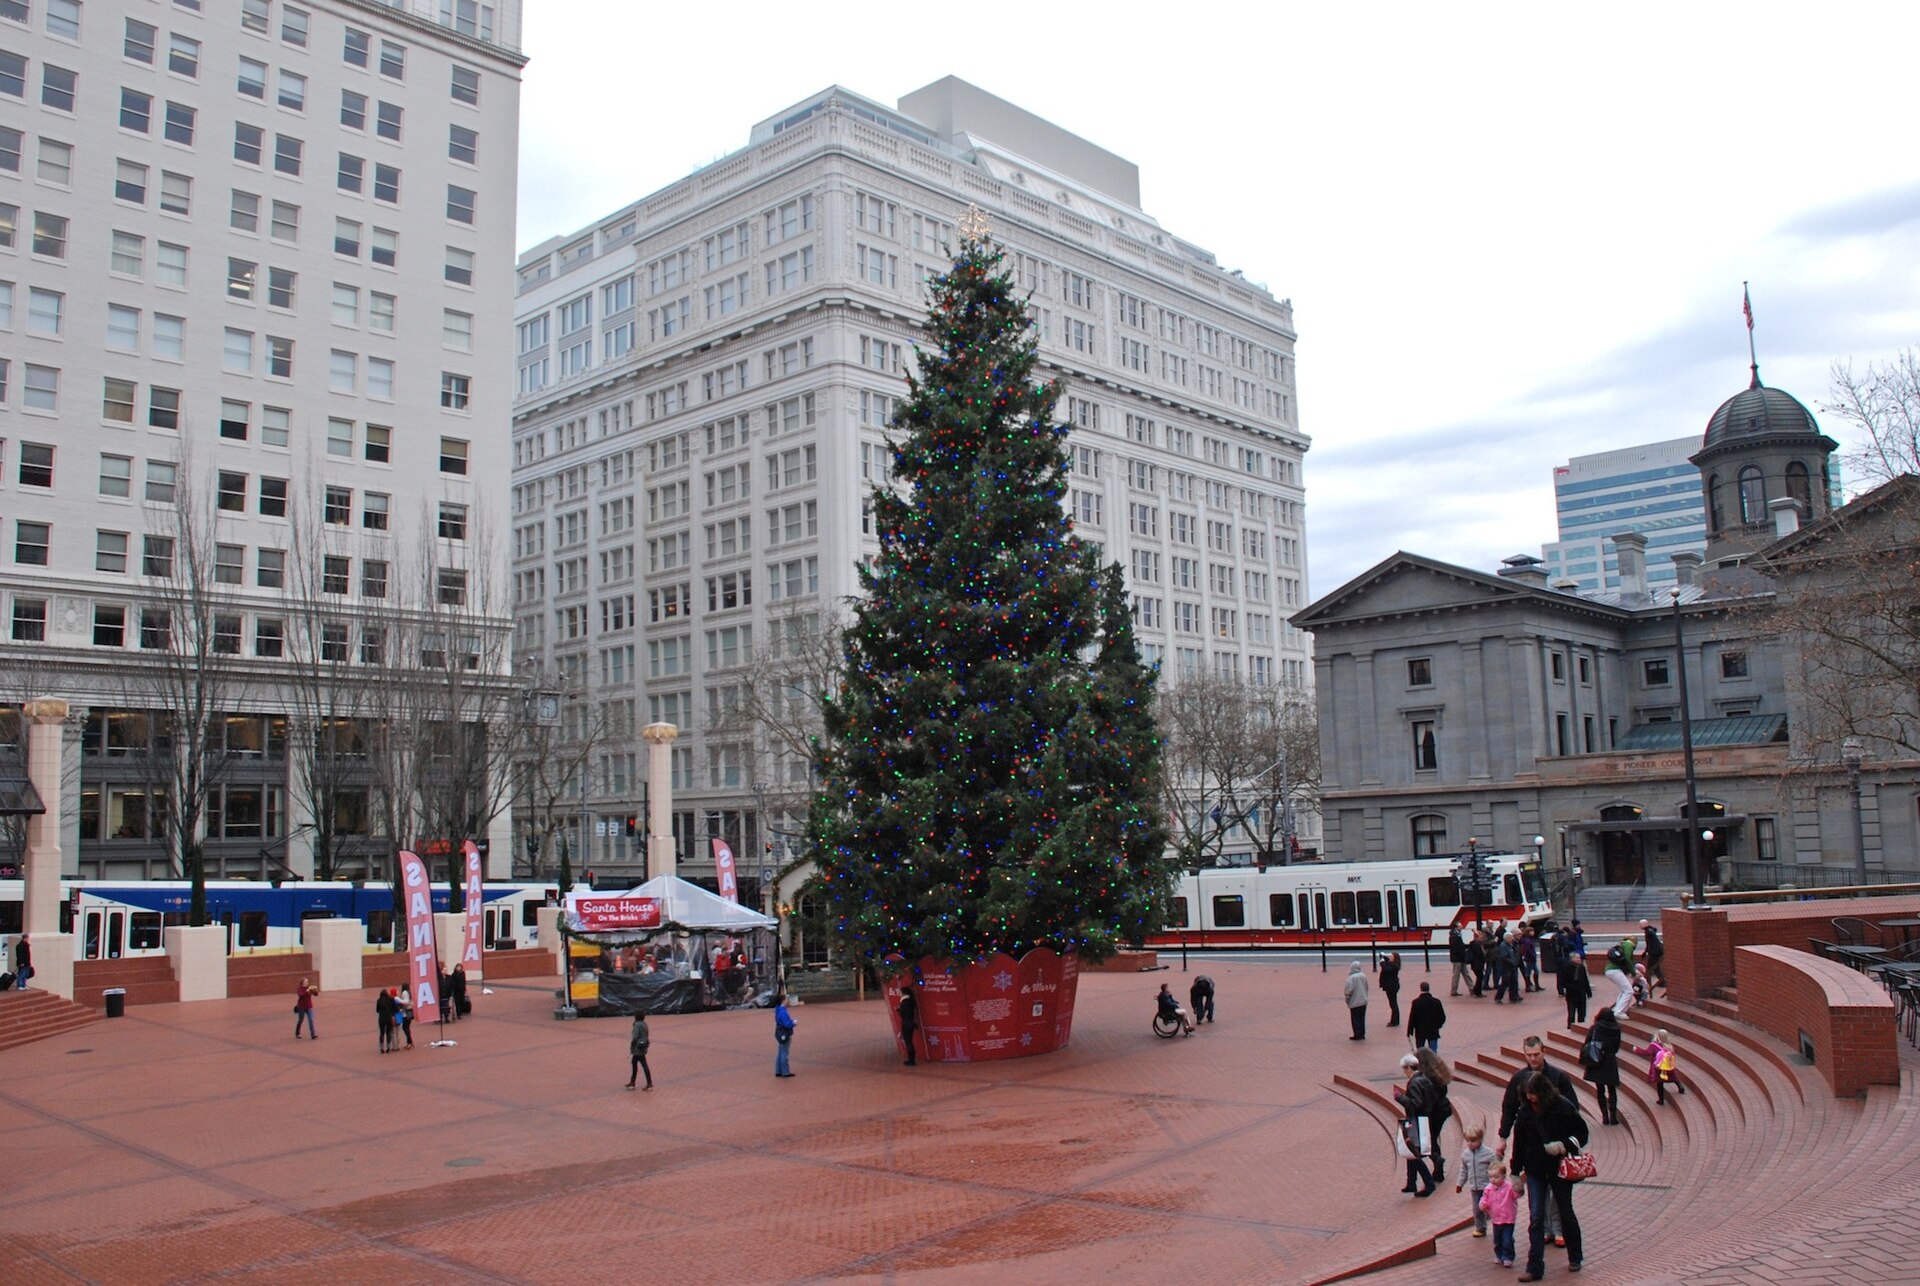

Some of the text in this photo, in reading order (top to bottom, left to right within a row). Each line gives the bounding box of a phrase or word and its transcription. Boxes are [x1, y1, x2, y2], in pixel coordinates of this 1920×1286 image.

[1624, 761, 1656, 769] PIONEER
[582, 901, 654, 913] Santa House
